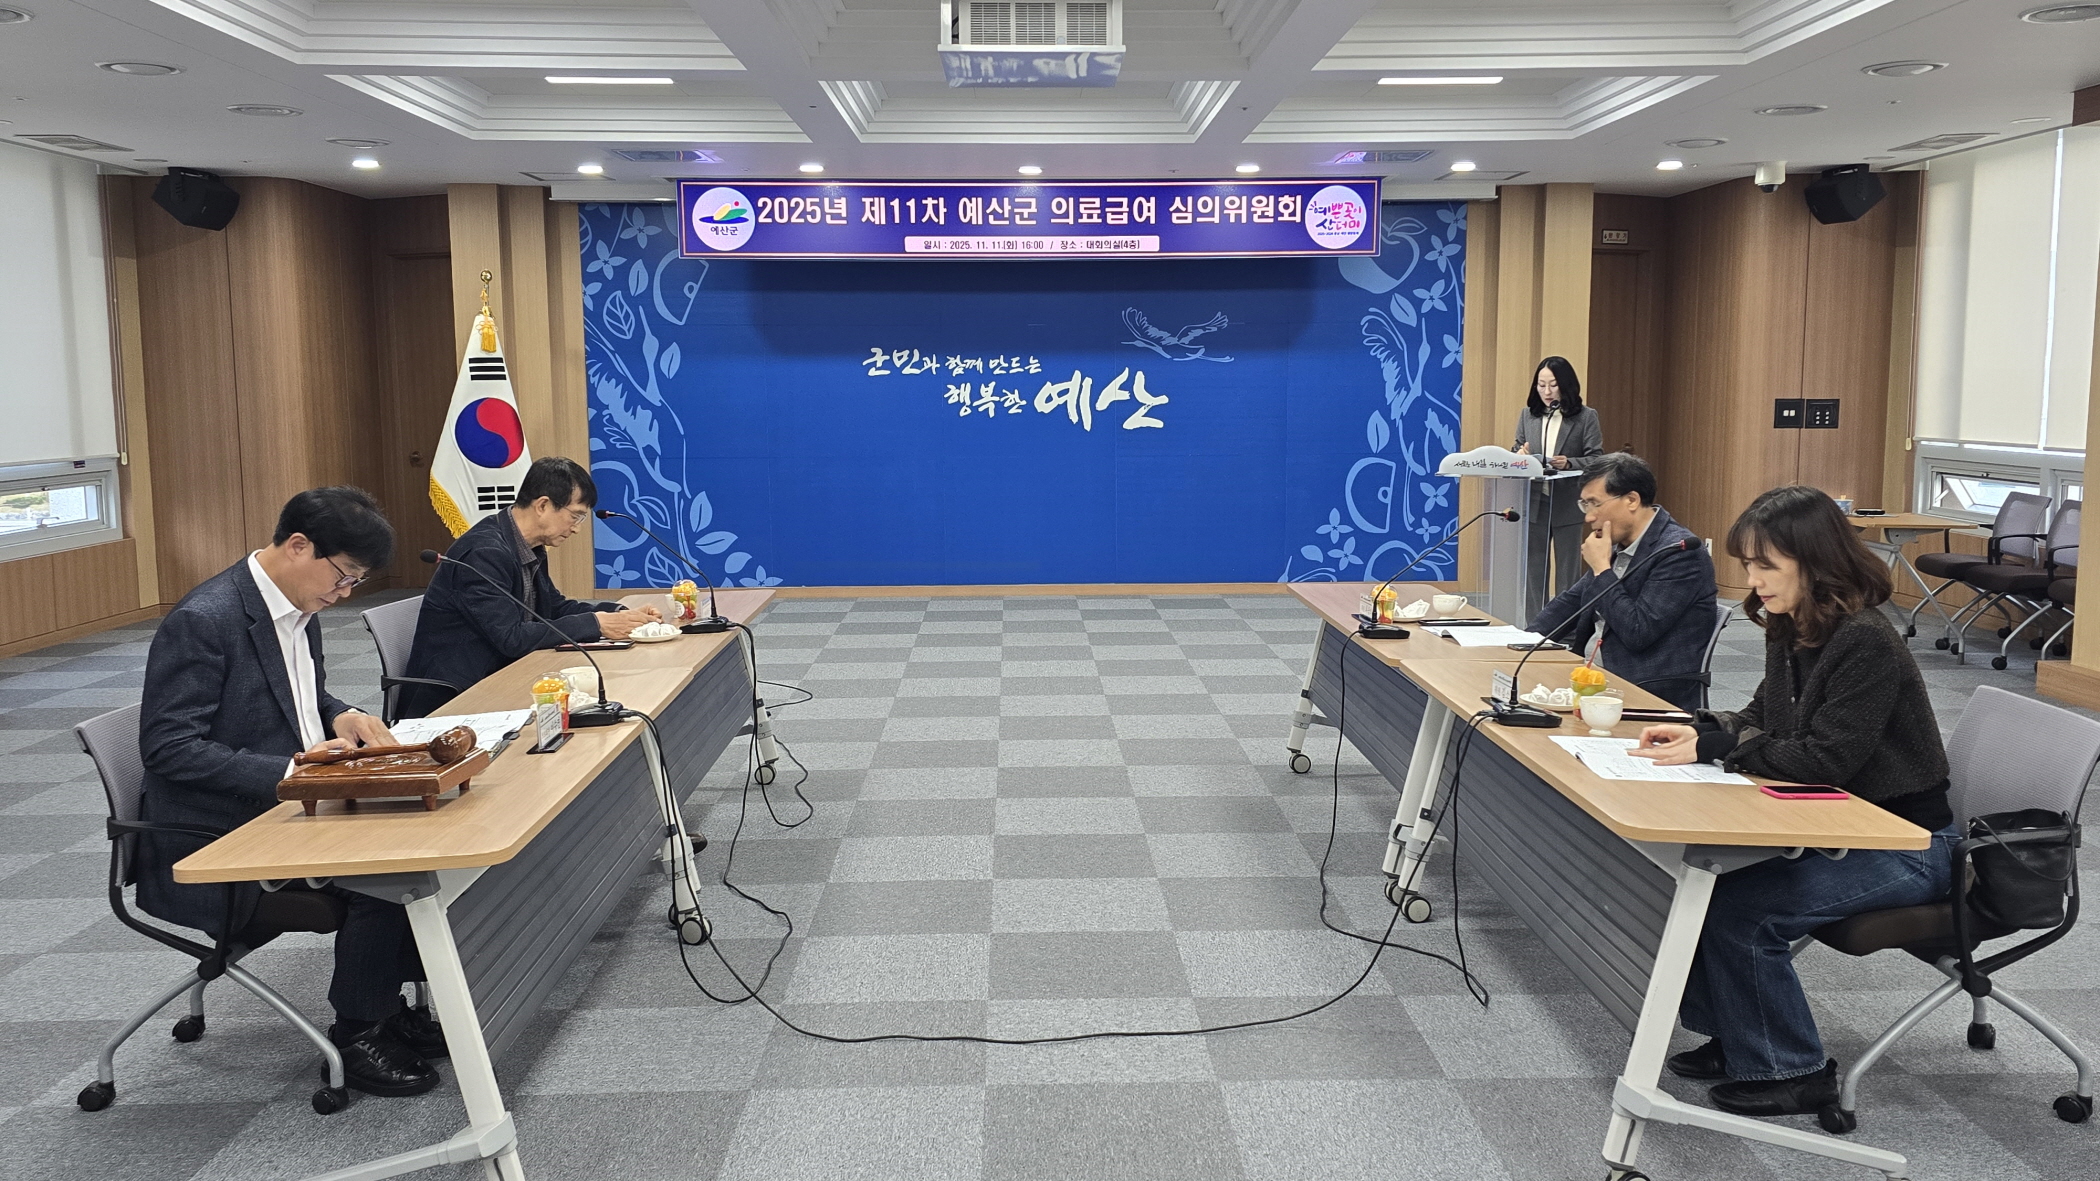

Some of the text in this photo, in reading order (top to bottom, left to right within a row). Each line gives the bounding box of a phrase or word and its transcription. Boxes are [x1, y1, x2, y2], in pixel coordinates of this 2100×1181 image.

[757, 194, 1302, 226] 2025년 제11차 예산군 의료급여 심의위원회
[710, 225, 739, 236] 예산군
[1315, 218, 1360, 231] 산더미
[923, 240, 941, 250] 일시
[949, 240, 973, 250] 2025.
[1021, 240, 1044, 250] 16:00
[1060, 240, 1077, 250] 장소
[1086, 239, 1140, 250] 대회의실(4층)
[862, 347, 1042, 377] 군민과 함께 만드는
[943, 366, 1170, 432] 행복한 예산
